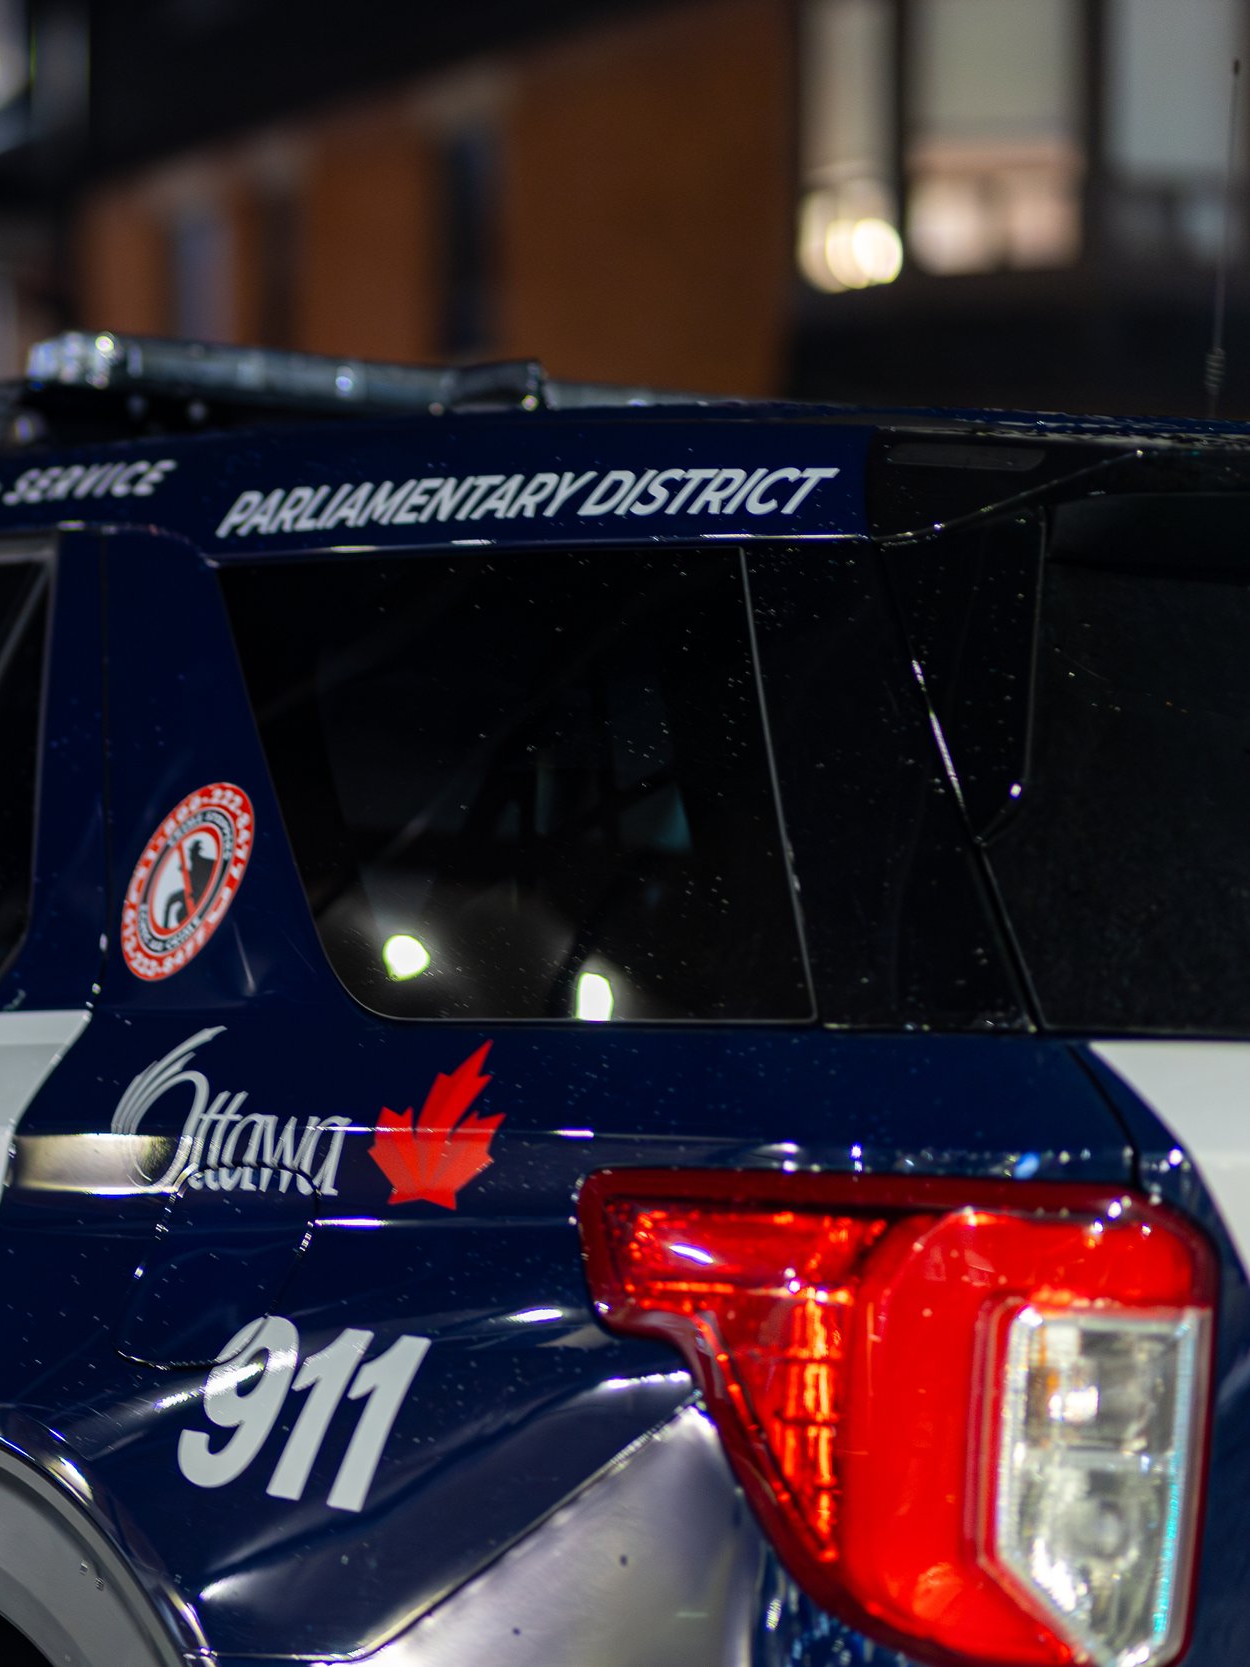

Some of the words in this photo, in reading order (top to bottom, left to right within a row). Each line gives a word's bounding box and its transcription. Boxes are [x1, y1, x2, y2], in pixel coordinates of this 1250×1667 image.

[2, 459, 177, 505] SERVICE
[215, 470, 598, 538] PARLIAMENTARY
[578, 467, 840, 517] DISTRICT
[111, 1025, 352, 1196] Ottawa
[177, 1315, 432, 1512] 911
